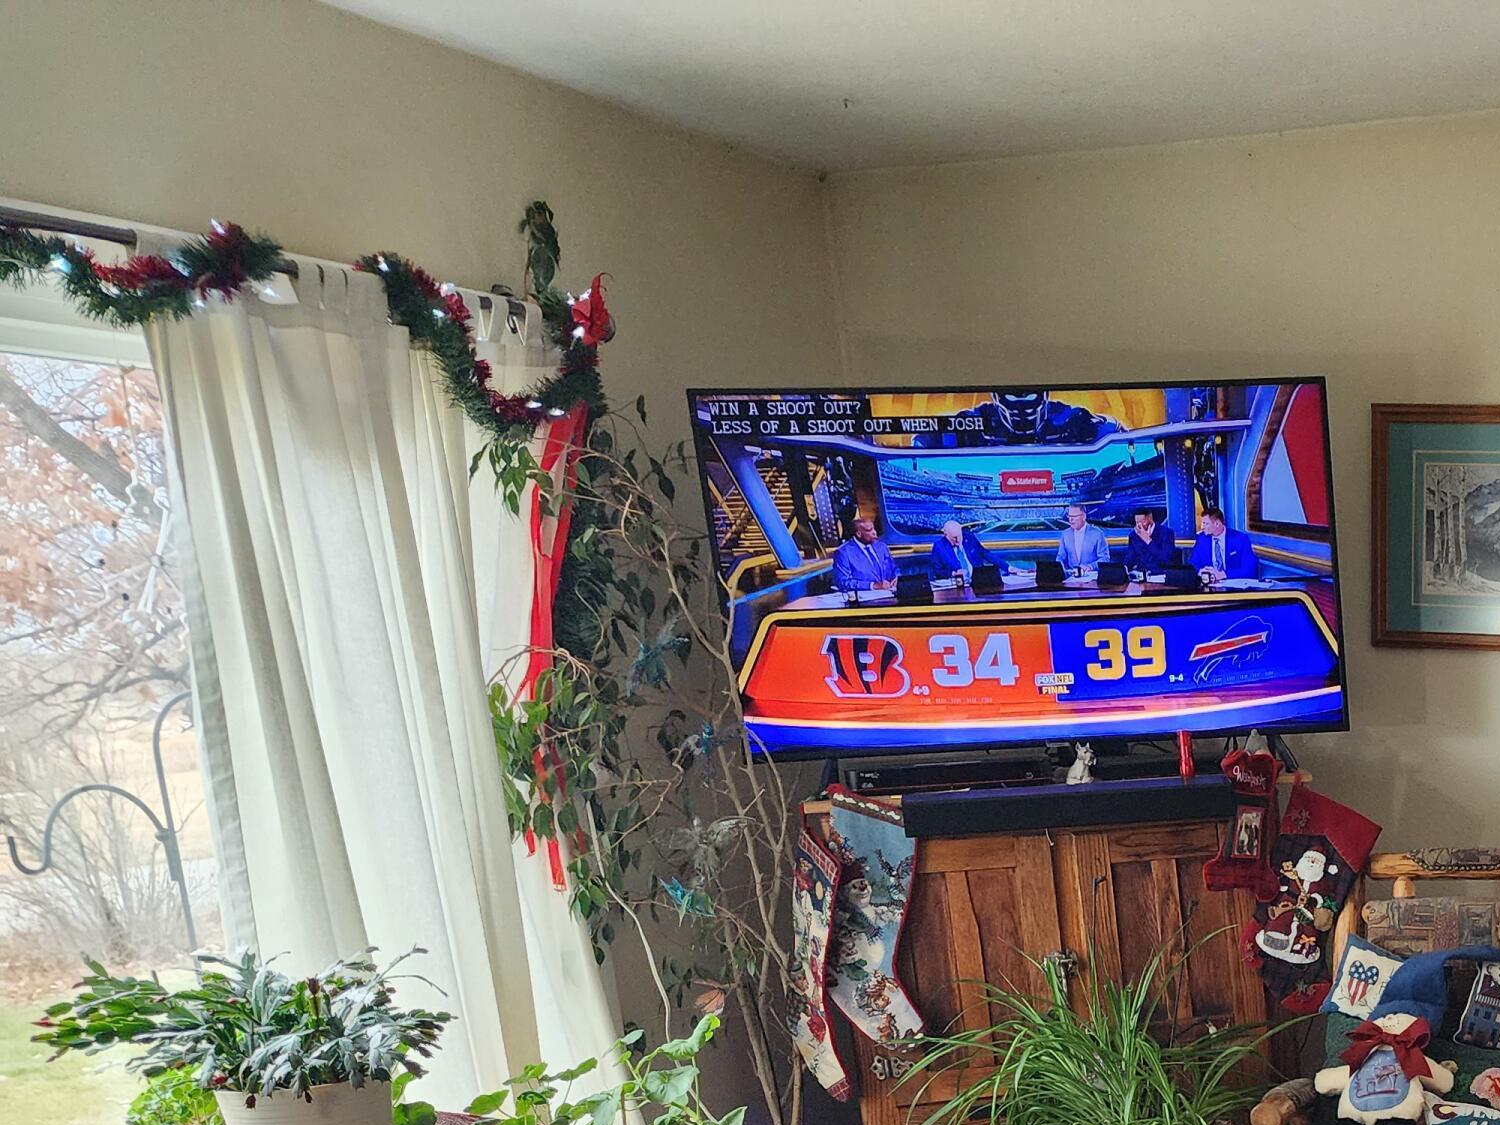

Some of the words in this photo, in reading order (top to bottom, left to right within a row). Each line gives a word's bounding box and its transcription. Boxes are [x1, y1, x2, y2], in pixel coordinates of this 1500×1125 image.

[708, 402, 740, 416] WIN
[749, 403, 760, 416] A
[767, 402, 816, 416] SHOOT
[824, 401, 862, 415] OUT?
[712, 420, 751, 435] LESS
[760, 420, 780, 434] OF
[789, 420, 800, 434] A
[808, 419, 856, 434] SHOOT
[863, 418, 893, 432] OUT
[902, 417, 939, 431] WHEN
[947, 417, 985, 431] JOSH
[928, 632, 1020, 688] 34
[1084, 625, 1167, 682] 39
[1042, 685, 1070, 695] FINAL
